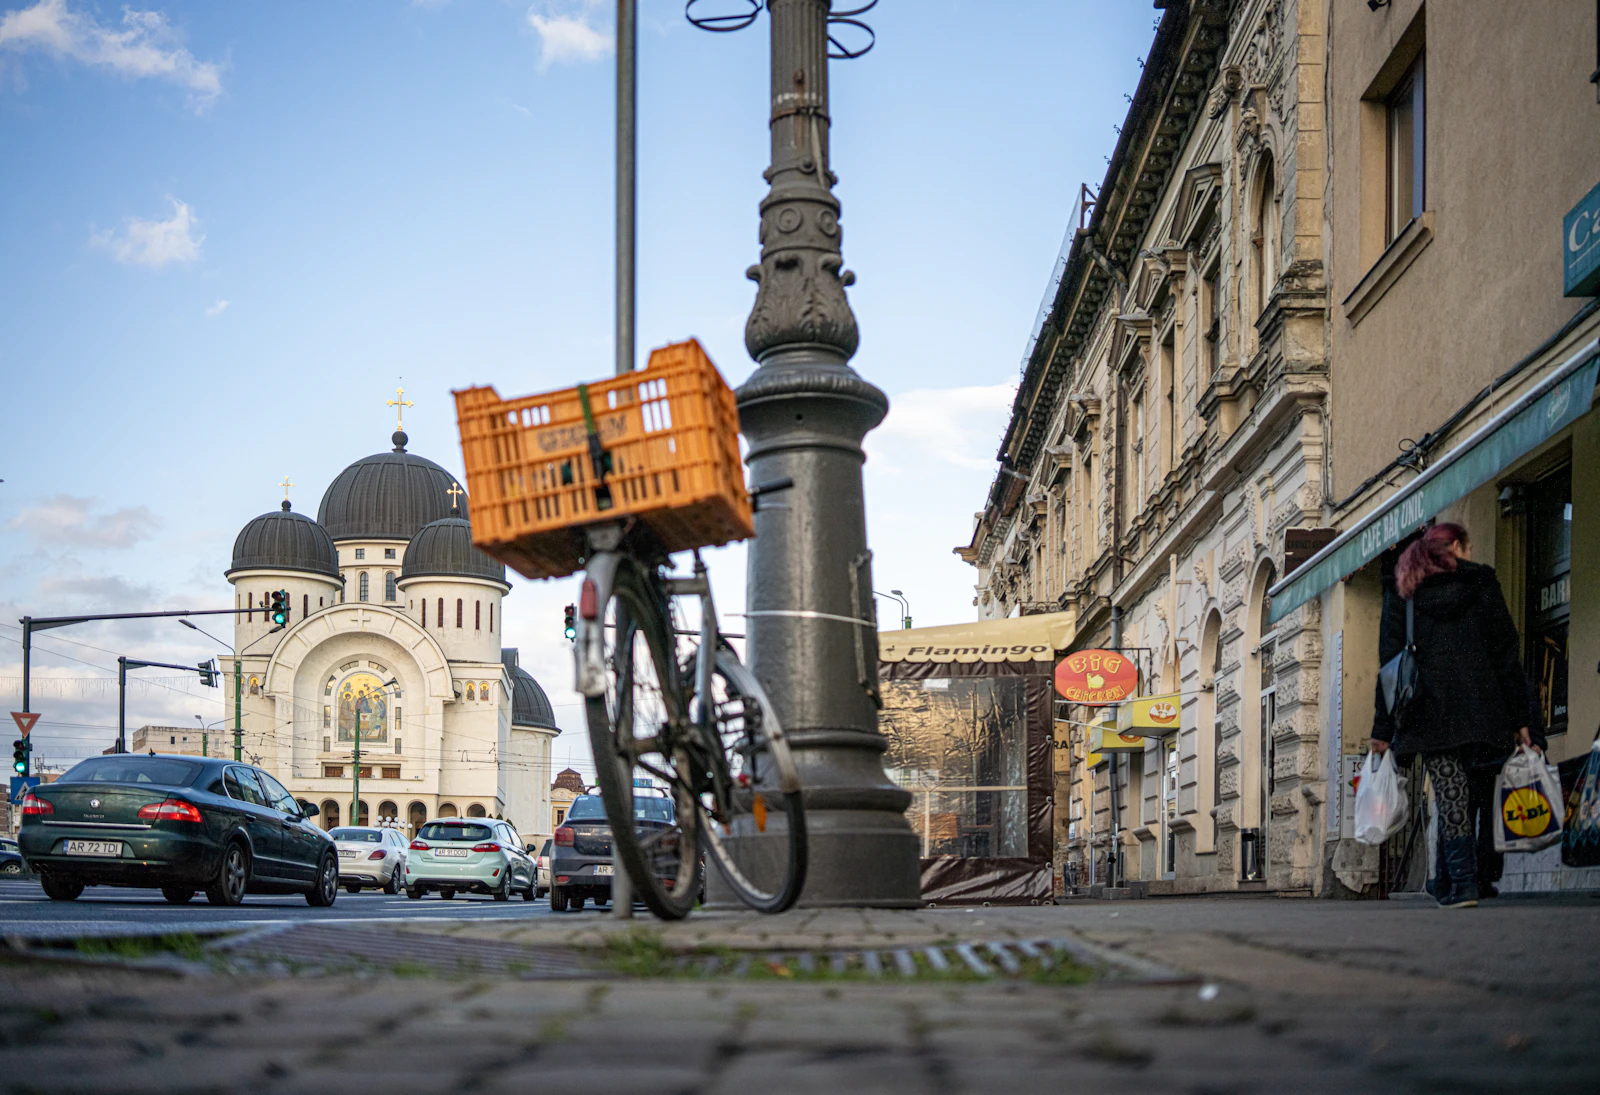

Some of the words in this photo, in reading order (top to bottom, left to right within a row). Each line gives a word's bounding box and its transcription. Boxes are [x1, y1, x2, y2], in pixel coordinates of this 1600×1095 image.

[1362, 521, 1381, 557] CAFE
[1383, 508, 1399, 542] BAR
[1401, 490, 1424, 529] UNIC
[908, 644, 1047, 656] Flamingo
[69, 842, 85, 852] AR
[88, 842, 100, 852] 72
[103, 843, 118, 853] TDI
[599, 866, 608, 874] AR
